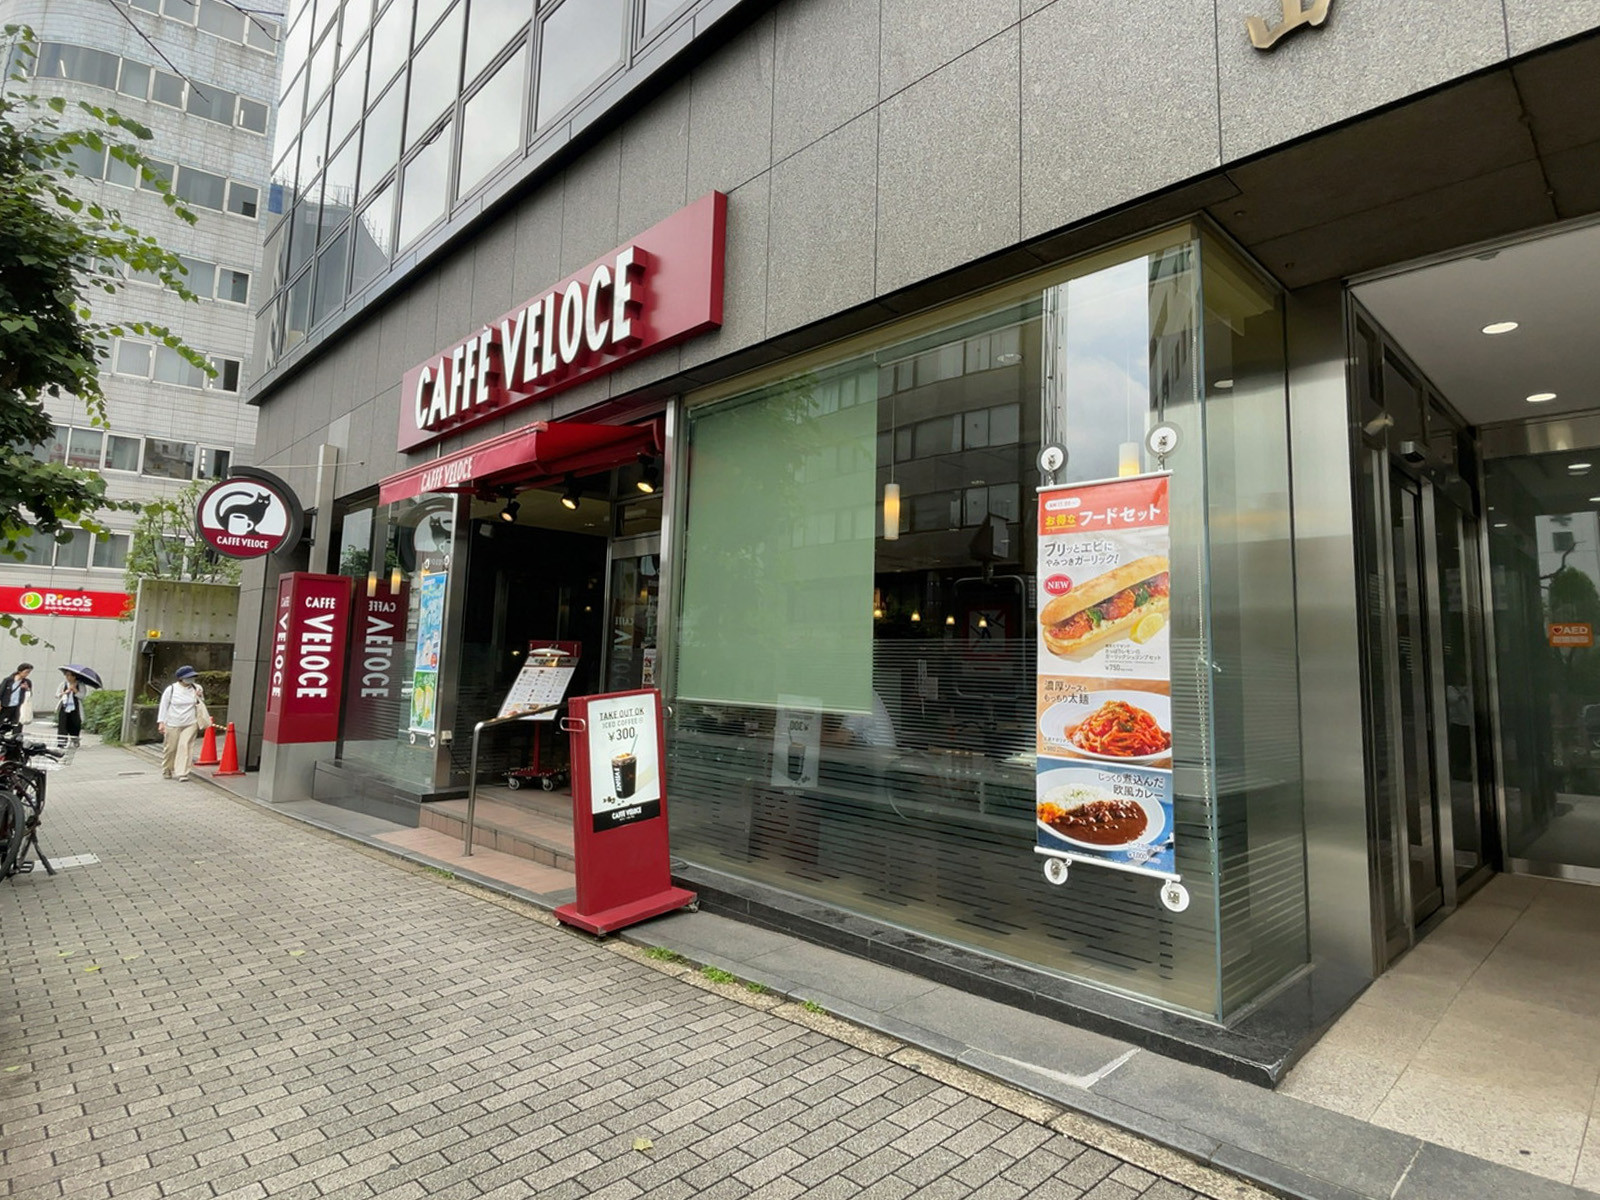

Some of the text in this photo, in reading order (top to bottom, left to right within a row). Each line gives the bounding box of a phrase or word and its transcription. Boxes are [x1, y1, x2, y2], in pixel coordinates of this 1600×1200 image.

[501, 245, 635, 391] VELOCE
[444, 456, 473, 485] VELOCE
[1045, 513, 1077, 527] お得な
[1079, 503, 1161, 526] フードセット
[216, 536, 269, 549] CAFFE VELOCE
[1047, 581, 1069, 590] NEW
[45, 593, 93, 608] Rico's
[305, 596, 336, 609] CAFFE
[1563, 626, 1588, 634] AED
[271, 612, 289, 697] VELOCE
[296, 613, 335, 698] VELOCE
[600, 707, 645, 721] TAKE OUT OK
[608, 726, 636, 742] ¥300
[1113, 784, 1164, 798] 欧風カレー
